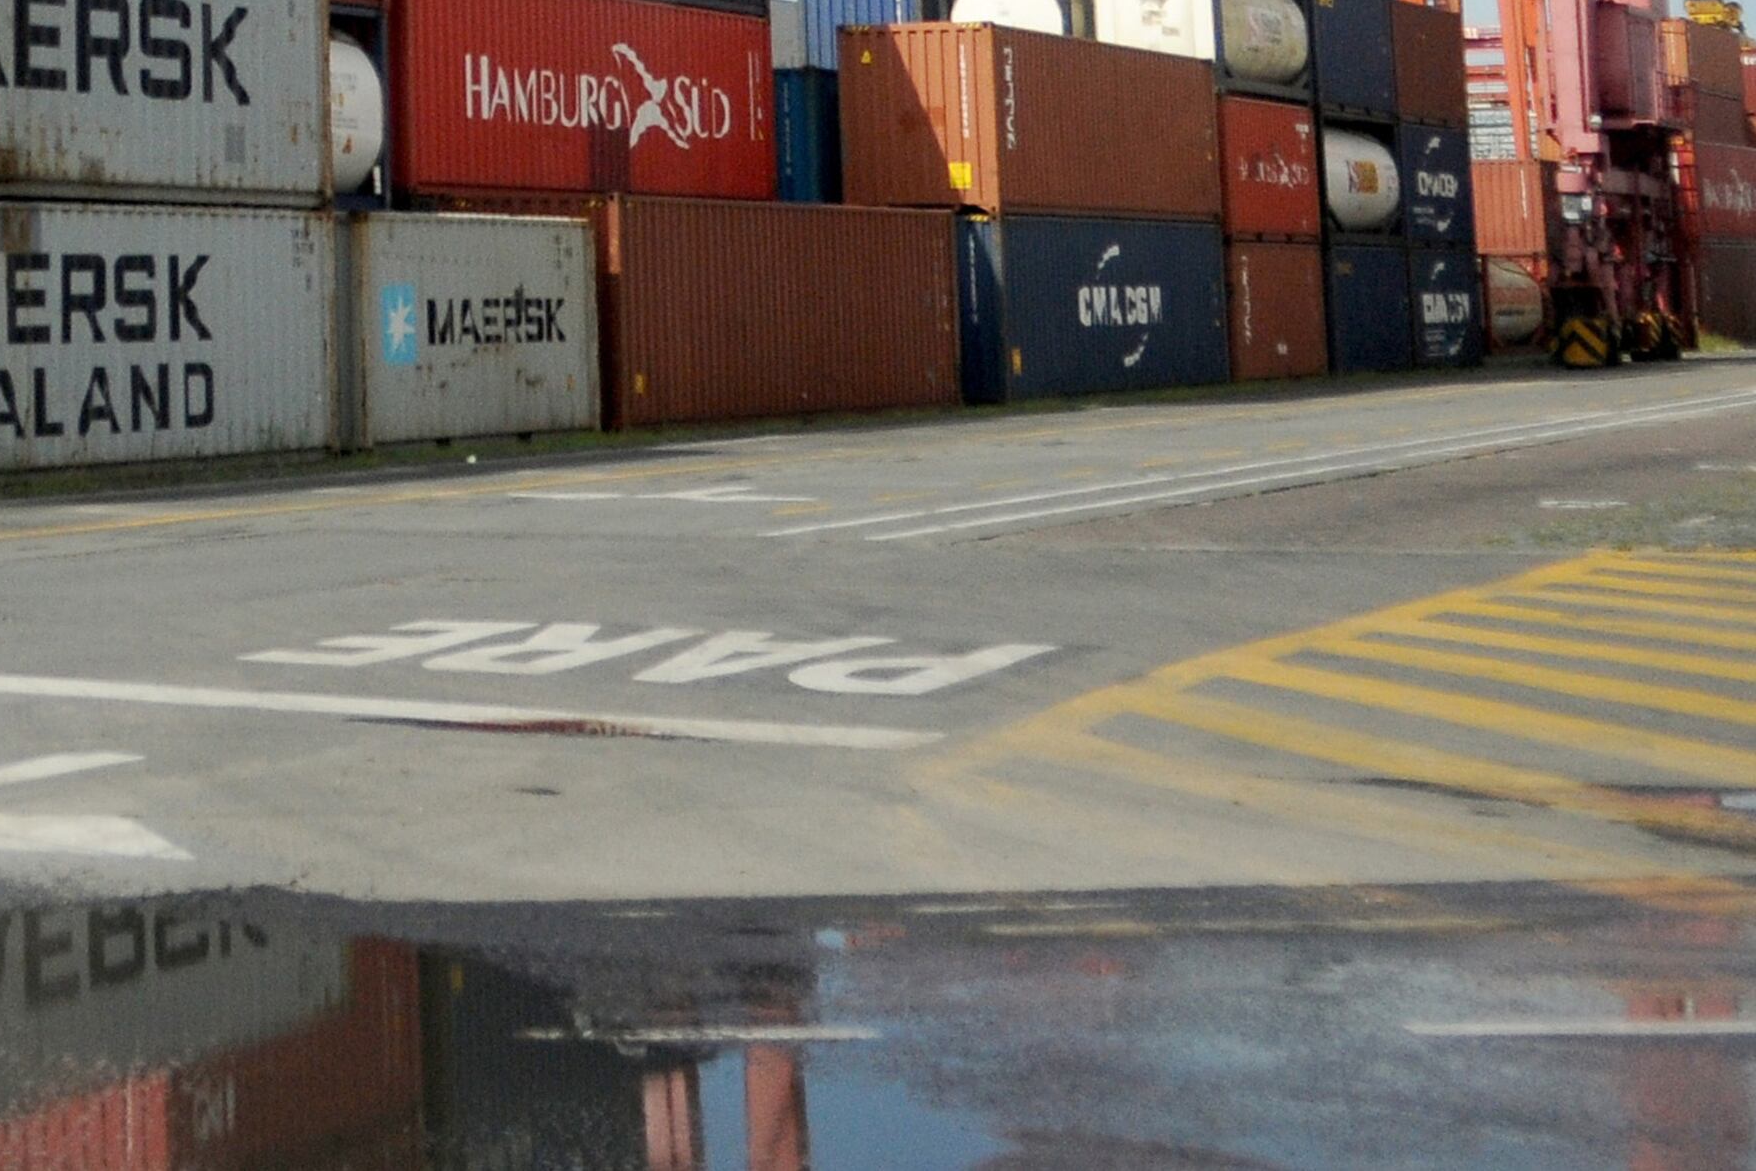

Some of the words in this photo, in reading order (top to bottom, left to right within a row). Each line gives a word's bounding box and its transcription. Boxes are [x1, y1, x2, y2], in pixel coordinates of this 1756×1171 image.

[463, 53, 623, 131] HAMBURG
[672, 76, 732, 139] SÜD
[426, 296, 568, 346] MAERSK
[1077, 285, 1124, 327] CMA
[1125, 285, 1164, 326] CGM
[234, 619, 1060, 697] PARE
